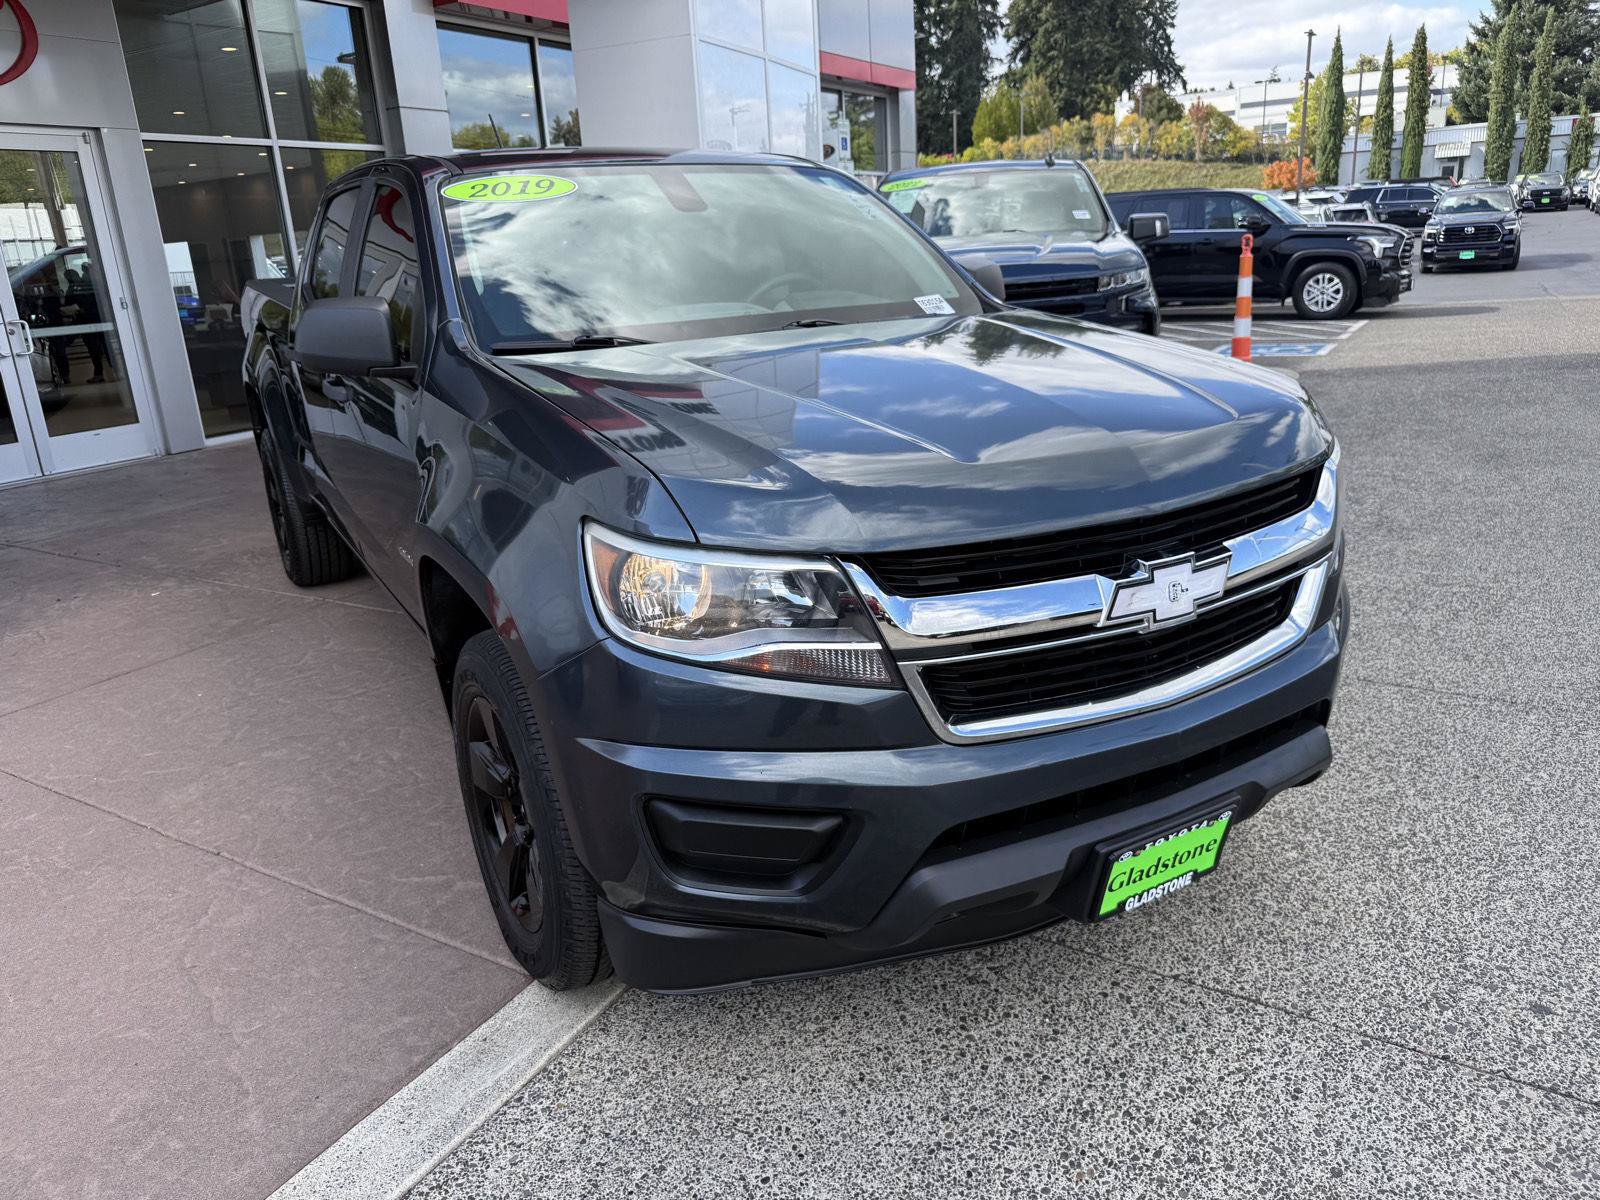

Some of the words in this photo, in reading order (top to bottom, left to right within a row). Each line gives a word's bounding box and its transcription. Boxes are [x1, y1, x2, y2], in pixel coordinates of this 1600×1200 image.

[469, 179, 555, 198] 2019
[1145, 820, 1208, 850] TOYOTA
[1107, 838, 1218, 893] Gladstone
[1125, 871, 1194, 912] GLADSTONE
